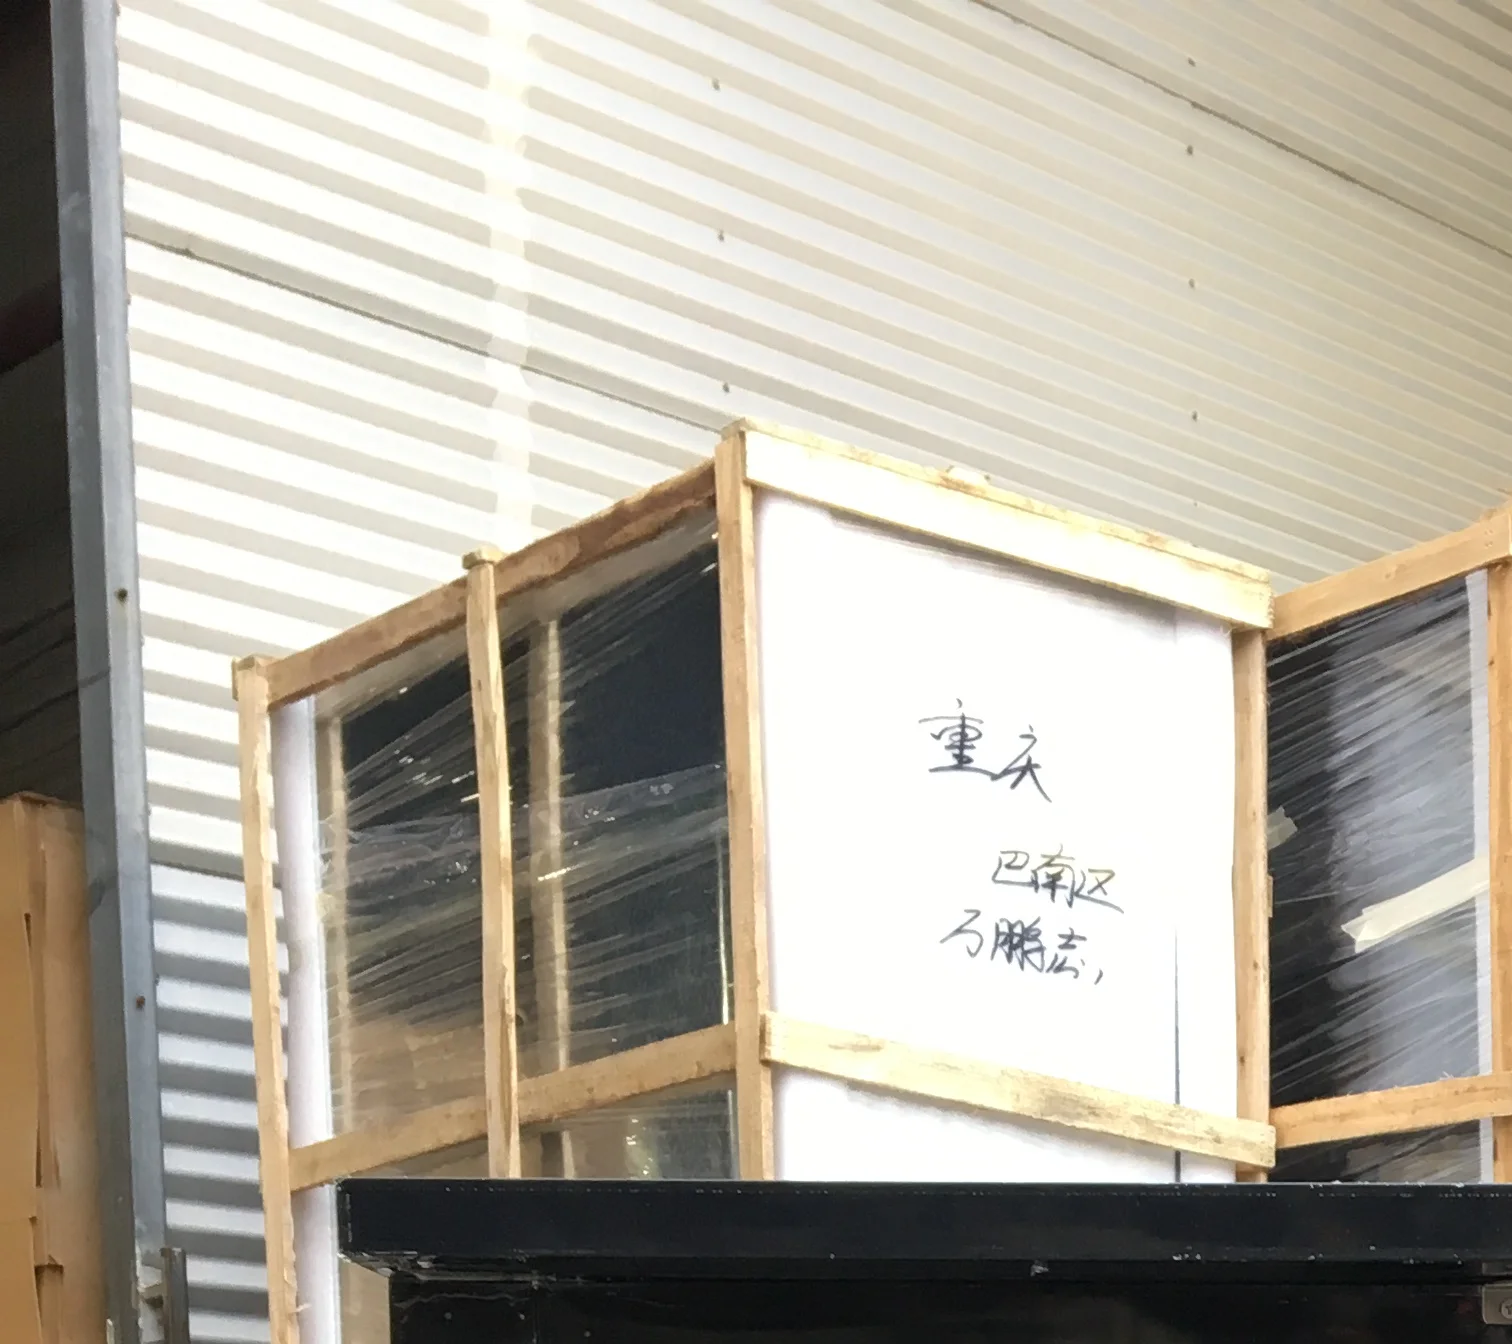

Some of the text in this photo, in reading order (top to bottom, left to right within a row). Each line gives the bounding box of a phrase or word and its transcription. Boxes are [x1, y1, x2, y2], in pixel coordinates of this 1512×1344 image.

[919, 698, 1052, 803] 重庆
[991, 845, 1125, 914] 巴南区
